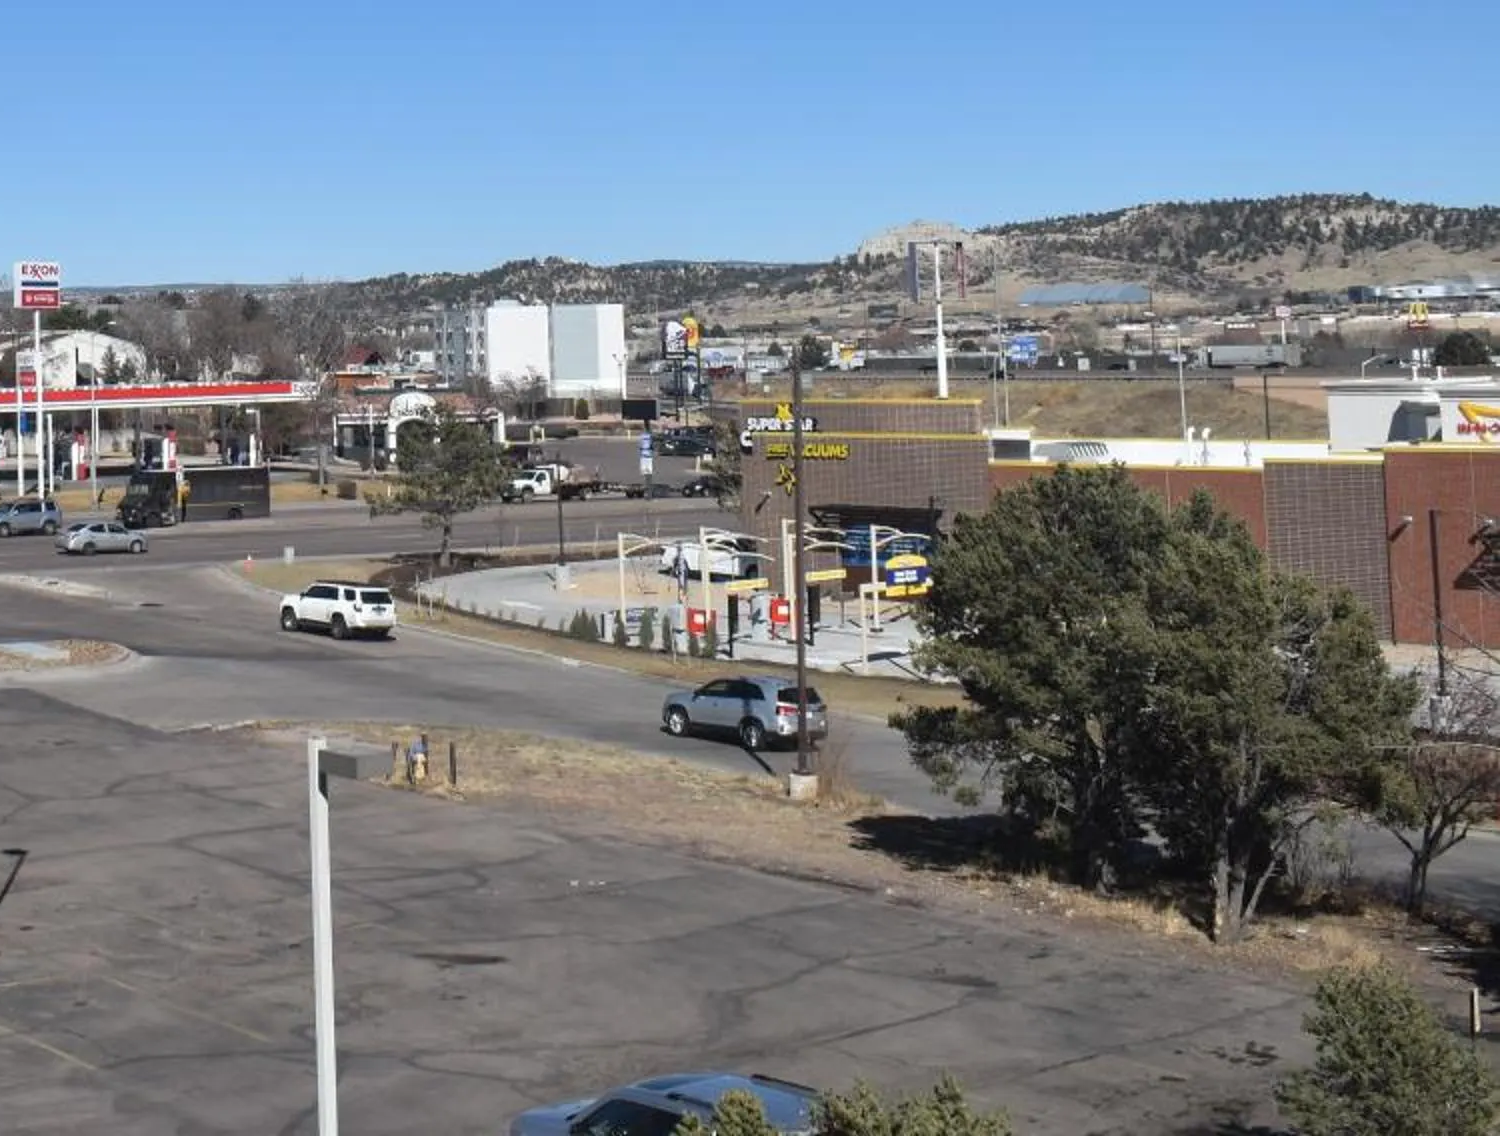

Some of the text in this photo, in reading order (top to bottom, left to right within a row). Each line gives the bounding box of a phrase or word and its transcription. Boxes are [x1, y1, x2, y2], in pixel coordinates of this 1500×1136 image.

[22, 264, 58, 280] EXXON
[748, 417, 813, 431] SUPER SAR
[789, 443, 849, 457] VCUUMS
